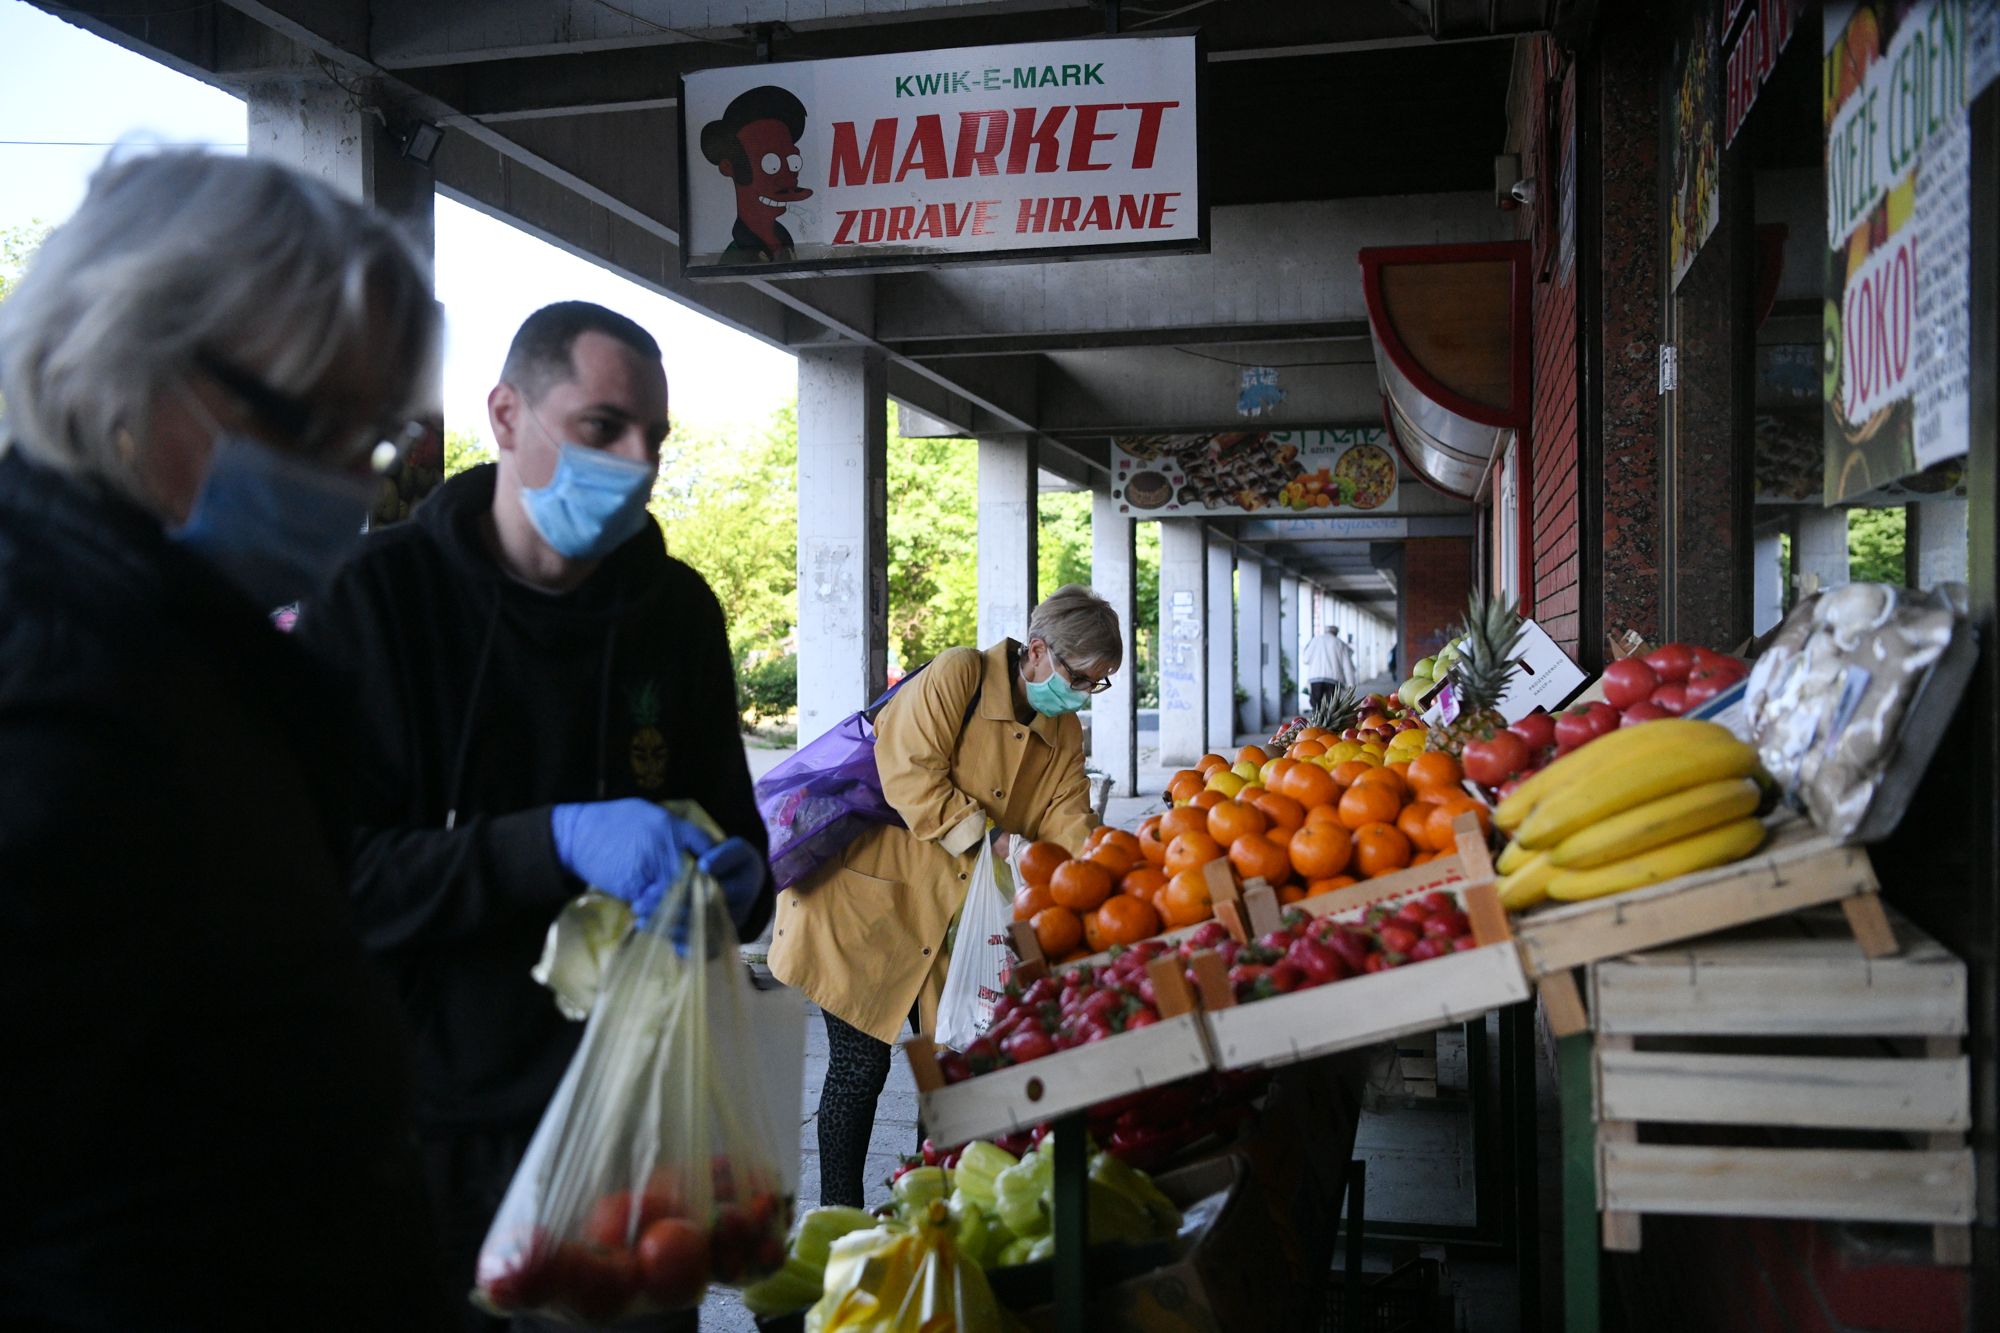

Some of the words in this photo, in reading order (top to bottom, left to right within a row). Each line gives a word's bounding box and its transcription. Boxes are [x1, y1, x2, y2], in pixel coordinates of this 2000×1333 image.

[895, 62, 1105, 98] KWIK-E-MARK
[828, 101, 1180, 188] MARKET
[831, 199, 1002, 245] ZDRAVE
[1015, 191, 1182, 234] HRANE
